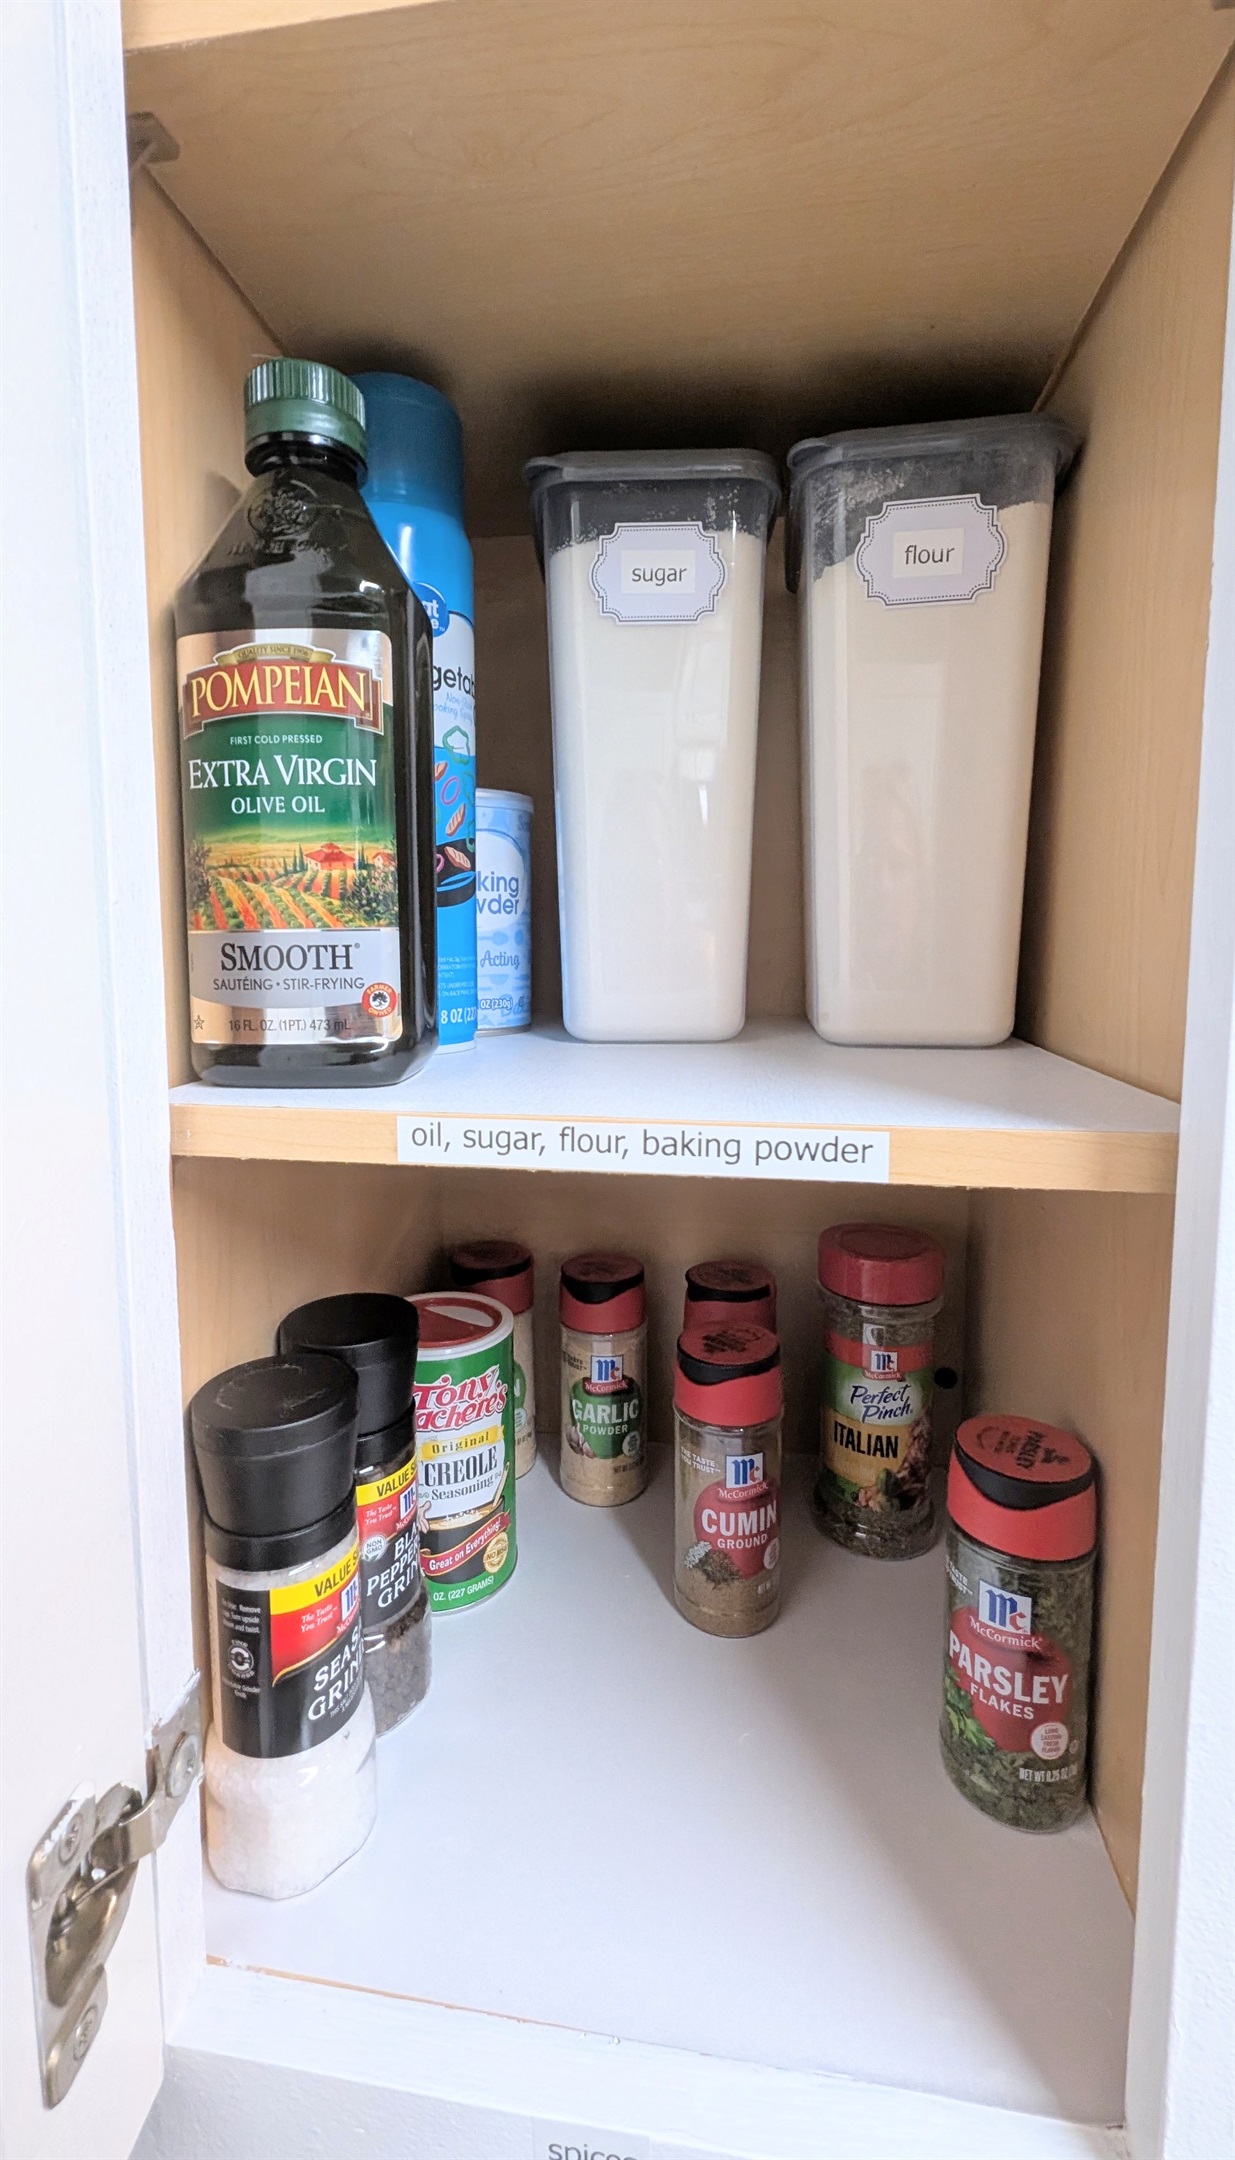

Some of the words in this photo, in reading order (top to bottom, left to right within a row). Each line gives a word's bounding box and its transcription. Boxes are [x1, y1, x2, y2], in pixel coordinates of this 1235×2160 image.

[904, 545, 955, 565] flour
[631, 567, 707, 587] sugar
[238, 646, 267, 659] QUALITY
[270, 645, 291, 655] SINCE
[191, 665, 367, 718] POMPEIAN
[229, 734, 252, 745] FIRST
[254, 734, 280, 744] COLD
[282, 734, 323, 744] PRESSED
[188, 758, 271, 790] EXTRA
[273, 754, 377, 787] VIRGIN
[231, 796, 286, 814] OLIVE
[291, 795, 325, 813] OIL
[477, 871, 520, 899] king
[480, 950, 520, 971] Acting
[213, 975, 273, 991] SAUTÉING
[283, 976, 365, 990] STIR-FRYING
[366, 984, 393, 995] FARMER
[368, 1007, 392, 1016] OWNED
[480, 999, 491, 1009] OZ
[229, 1020, 240, 1032] 16
[260, 1019, 277, 1031] OZ.
[309, 1019, 330, 1031] 473
[334, 1020, 351, 1031] mL
[440, 1009, 449, 1025] 8
[450, 1007, 463, 1024] OZ
[411, 1121, 451, 1152] oil,
[462, 1127, 547, 1157] sugar,
[558, 1126, 629, 1161] flour,
[642, 1129, 742, 1166] baking
[753, 1135, 874, 1166] powder
[584, 1380, 628, 1393] McCormick
[850, 1382, 912, 1406] Perfect
[572, 1399, 639, 1425] GARLIC
[861, 1395, 910, 1423] Pinch
[582, 1423, 628, 1436] POWDER
[833, 1419, 899, 1459] ITALIAN
[431, 1431, 489, 1454] Original
[424, 1445, 497, 1487] CREOLE
[692, 1453, 716, 1468] TASTE
[692, 1460, 714, 1474] TRUST
[376, 1467, 410, 1498] VALUE
[431, 1474, 494, 1501] Seasoning
[717, 1480, 769, 1499] McCormick
[365, 1508, 377, 1518] The
[701, 1500, 777, 1537] CUMIN
[366, 1538, 382, 1549] NON
[366, 1545, 383, 1555] GMO
[429, 1557, 453, 1571] Great
[454, 1550, 464, 1562] on
[465, 1519, 501, 1555] Everything!
[717, 1534, 768, 1549] GROUND
[313, 1560, 352, 1598] VALUE
[433, 1590, 446, 1602] OZ.
[447, 1587, 466, 1601] (227
[467, 1575, 494, 1595] GRAMS)
[239, 1603, 261, 1614] Remove
[301, 1612, 315, 1623] The
[316, 1603, 333, 1617] Taste
[234, 1624, 245, 1632] and
[242, 1616, 260, 1624] upside
[301, 1623, 315, 1633] You
[316, 1611, 333, 1626] Trust
[969, 1615, 1041, 1650] McCormick
[949, 1630, 1069, 1704] PARSLEY
[970, 1682, 1035, 1720] FLAKES
[1019, 1767, 1034, 1781] NET
[1034, 1770, 1046, 1783] WT
[548, 2143, 638, 2160] spi
